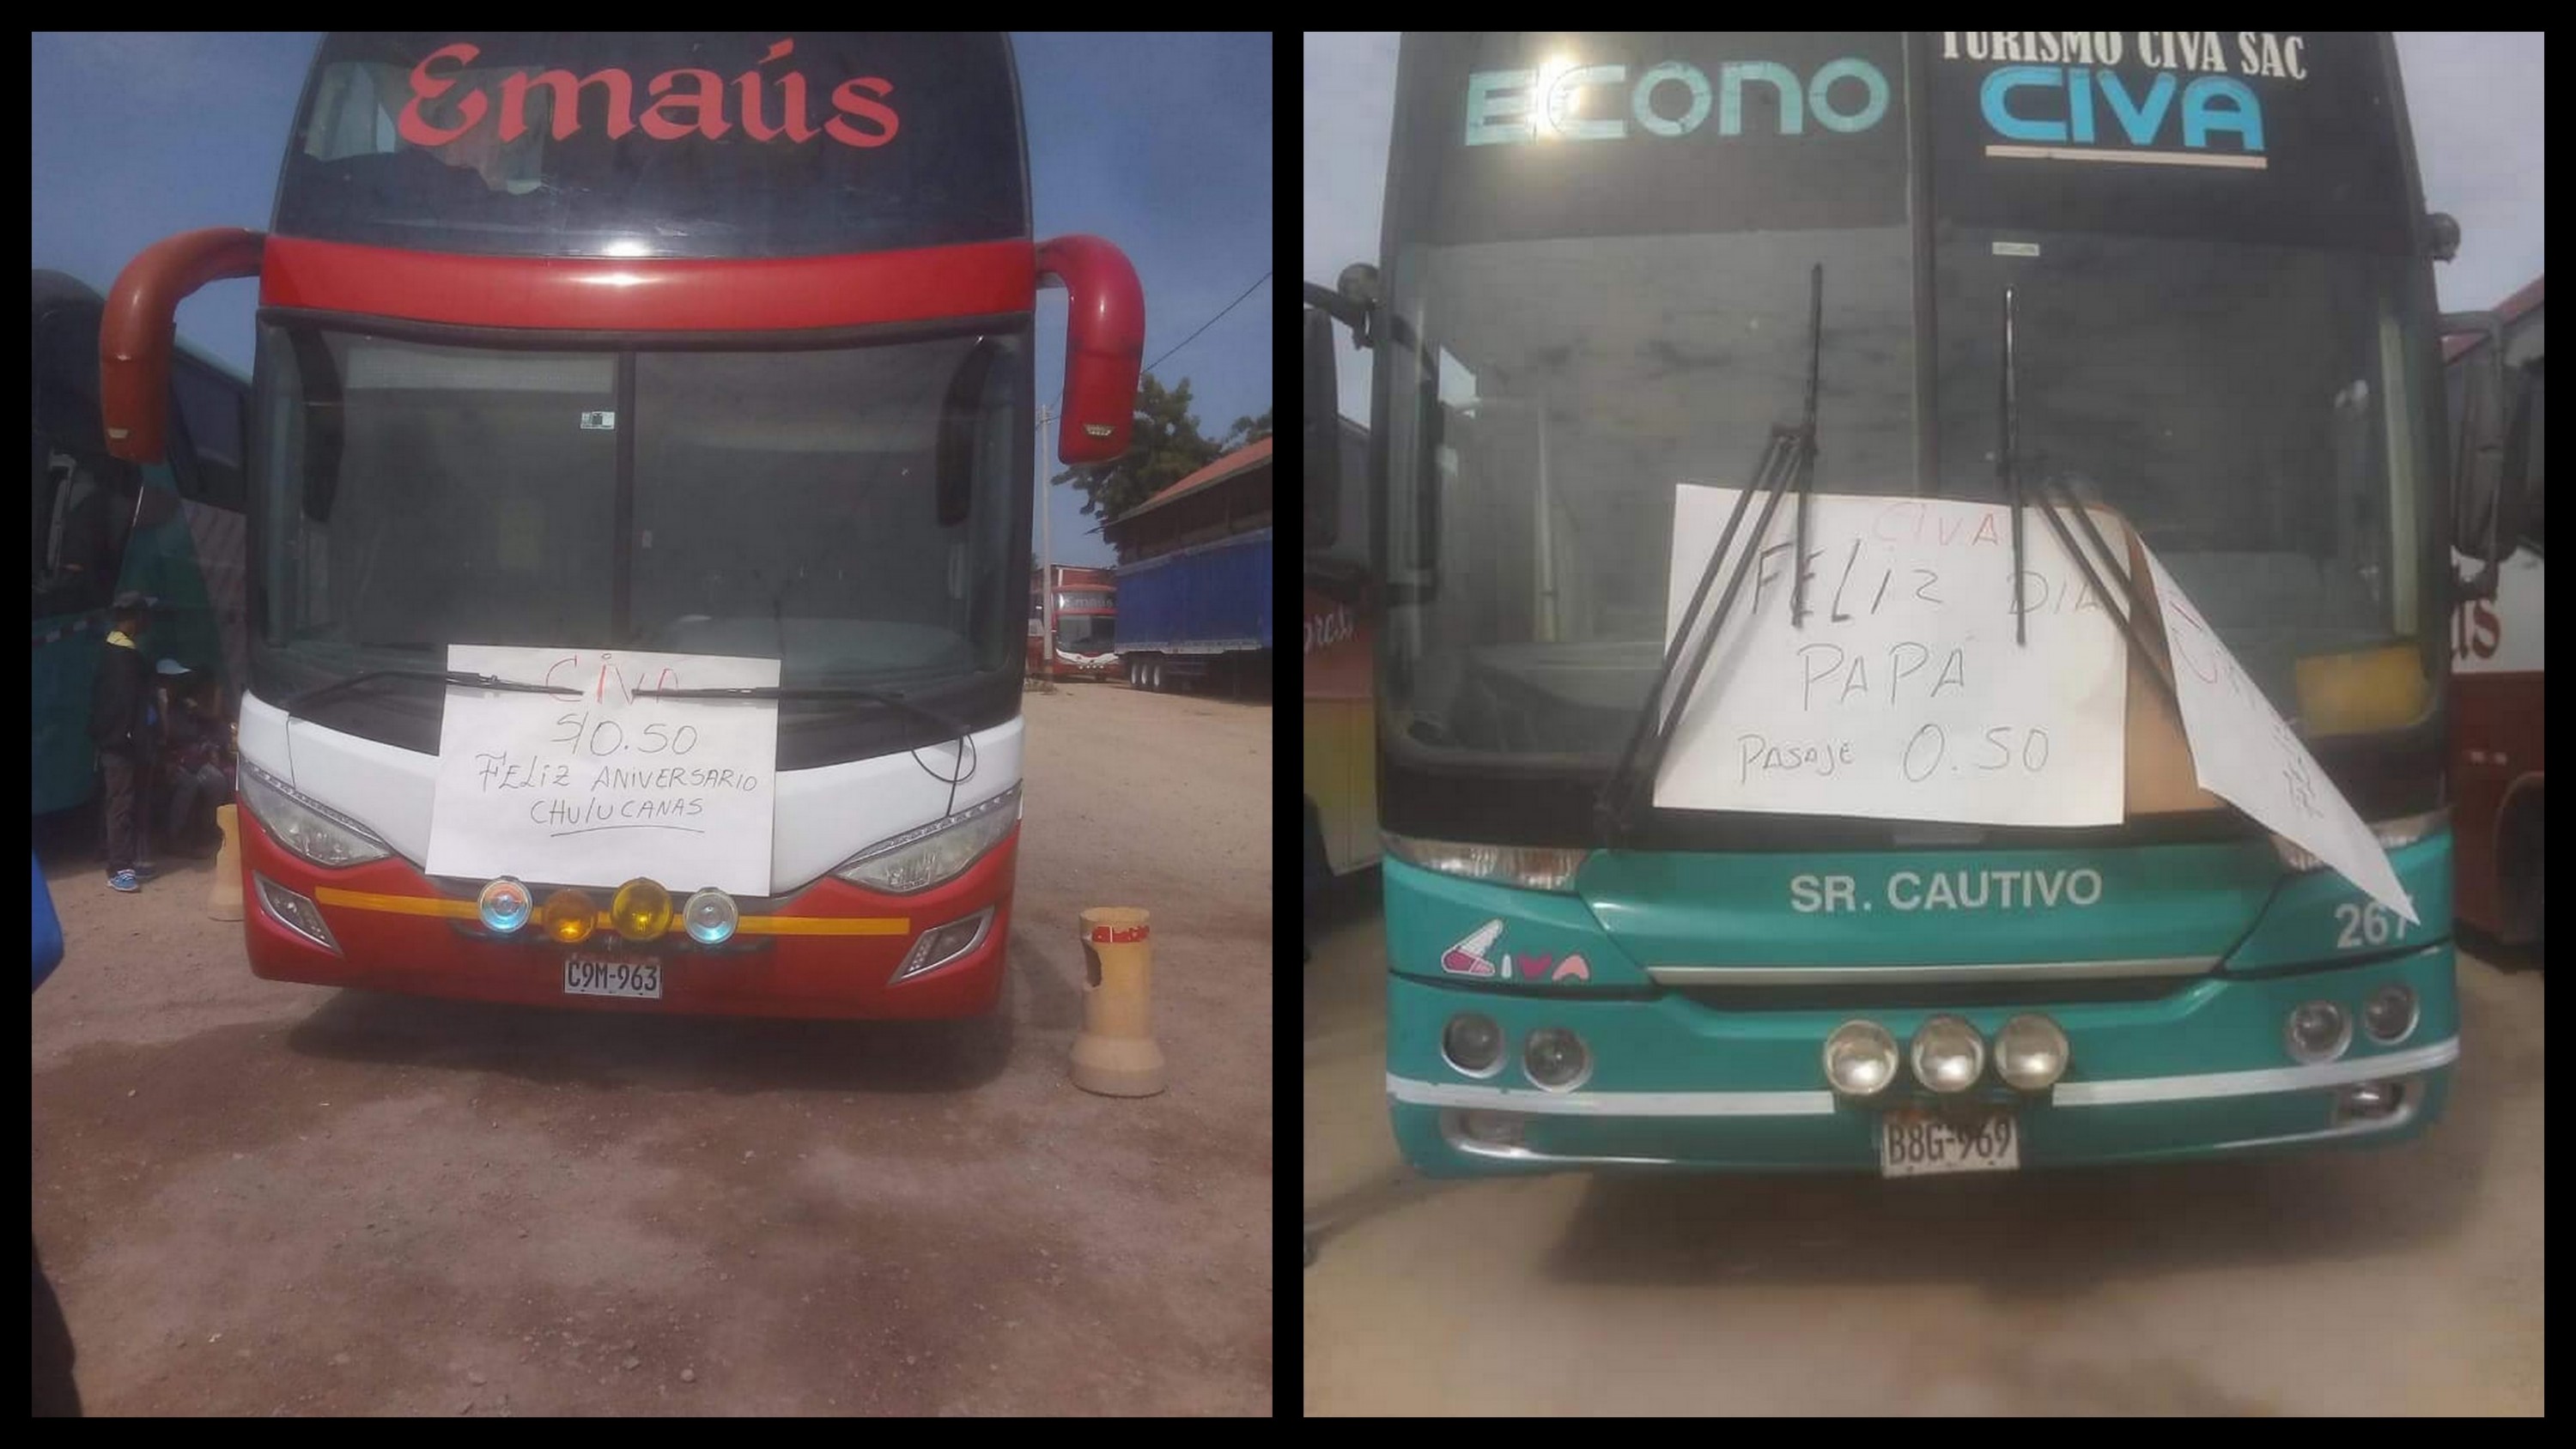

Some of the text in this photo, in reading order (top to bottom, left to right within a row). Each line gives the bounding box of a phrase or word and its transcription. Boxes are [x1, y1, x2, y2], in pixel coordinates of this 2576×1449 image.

[1943, 31, 2307, 80] TURISMO CIVA SAC
[398, 38, 900, 148] Emaús
[1980, 65, 2265, 151] CIVA
[1904, 724, 2049, 781] 0.50
[1790, 869, 2102, 912] SR. CAUTIVO
[568, 961, 658, 991] C9M-963
[1889, 1118, 2010, 1165] B8G-969
